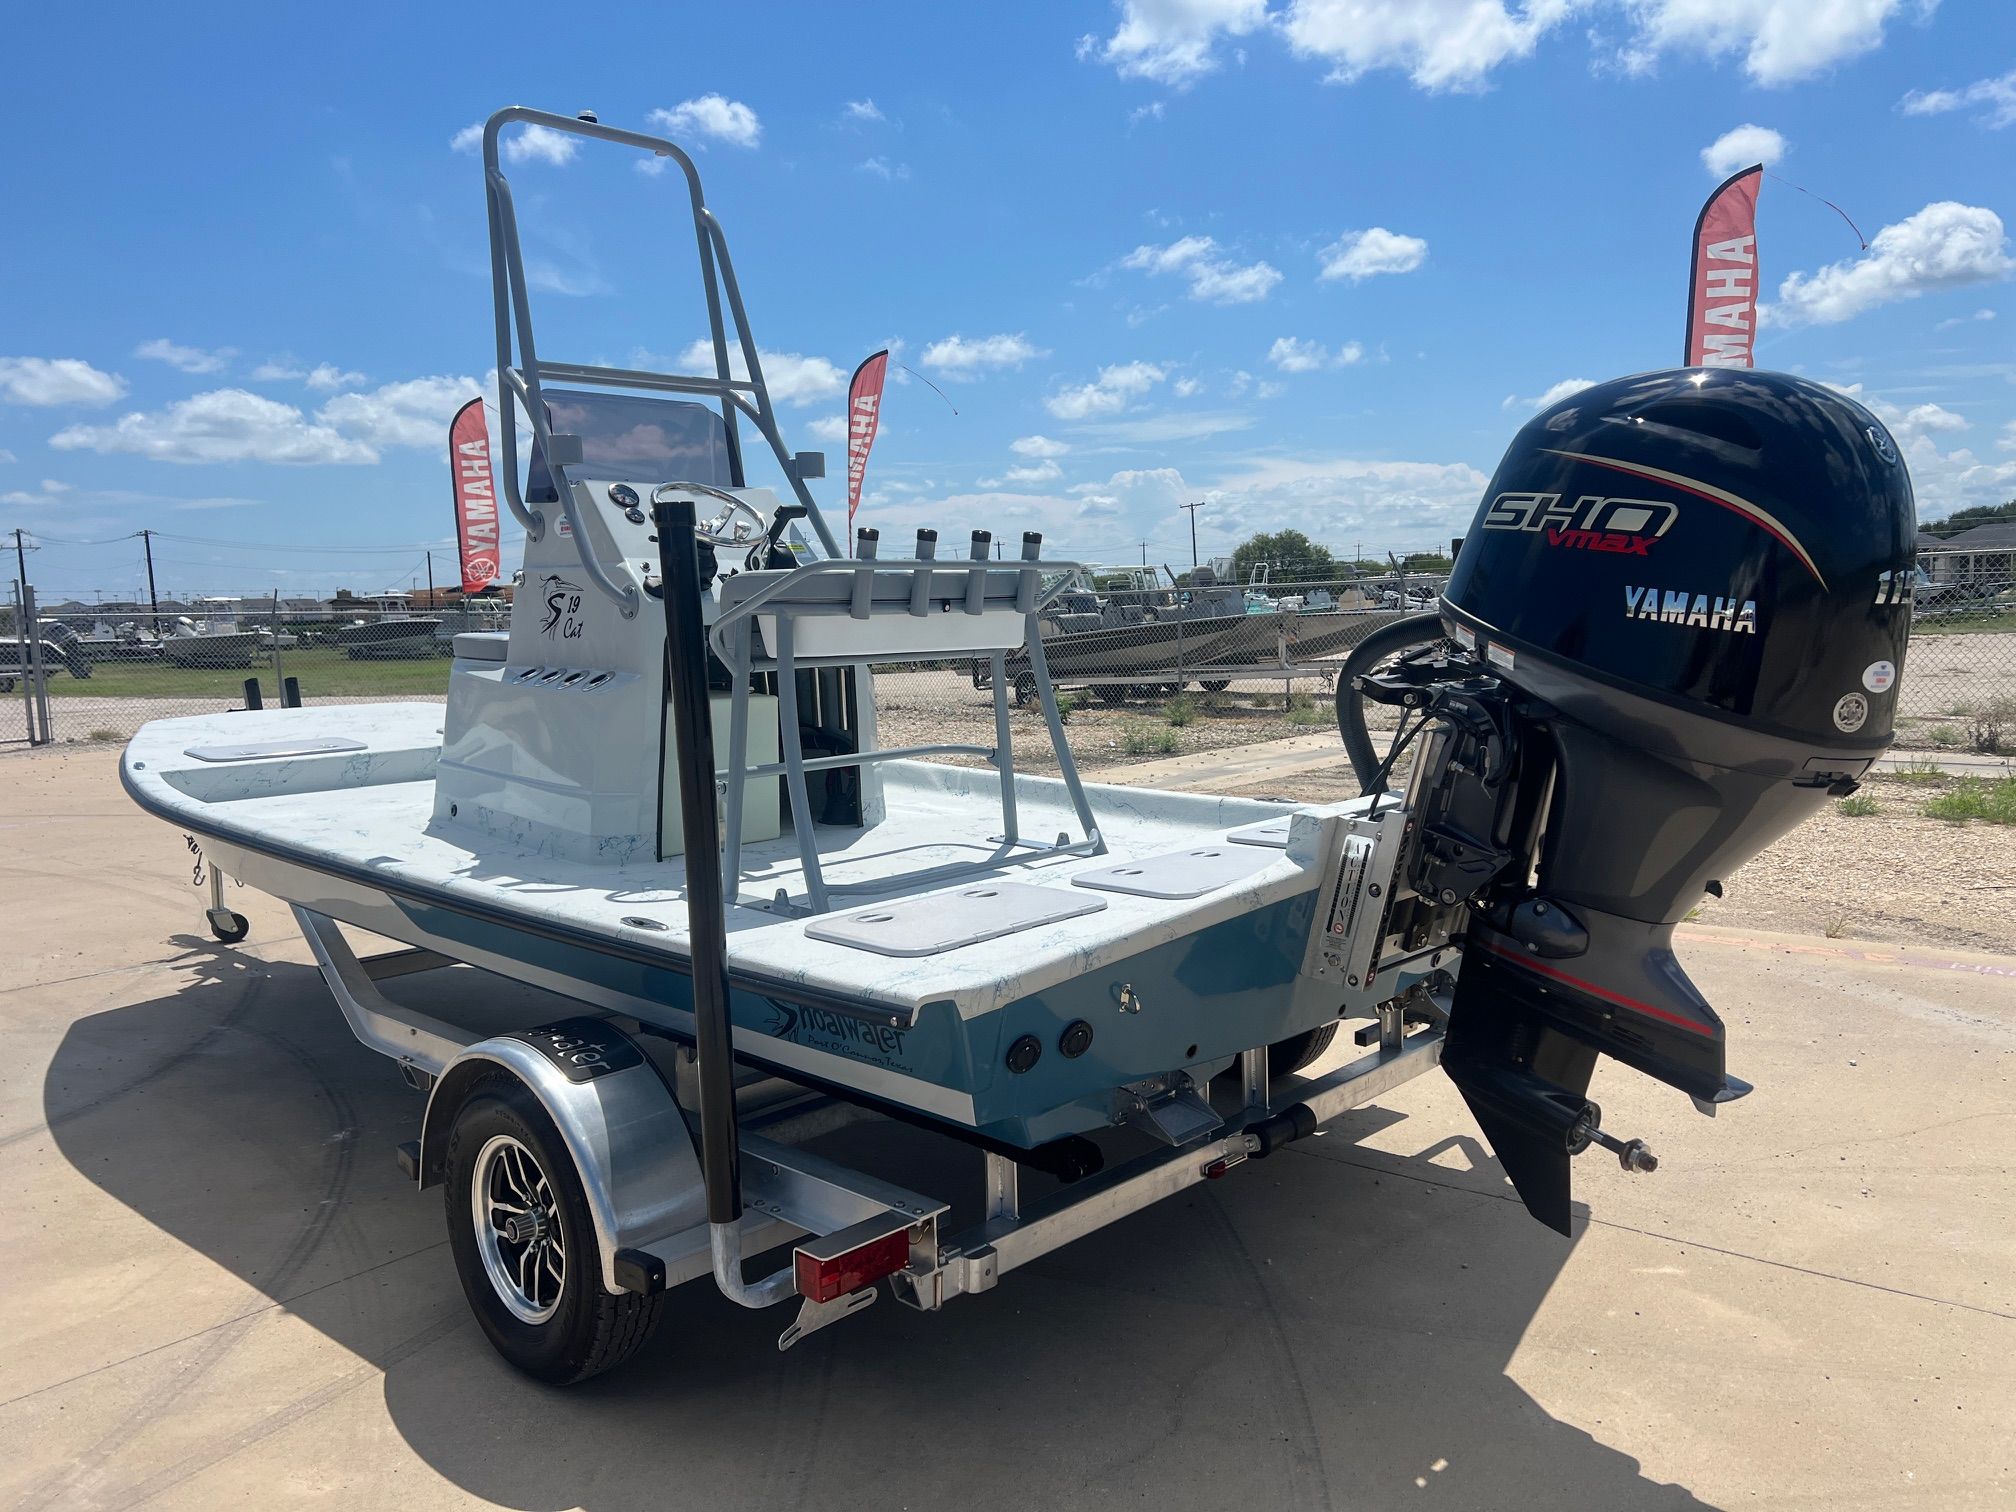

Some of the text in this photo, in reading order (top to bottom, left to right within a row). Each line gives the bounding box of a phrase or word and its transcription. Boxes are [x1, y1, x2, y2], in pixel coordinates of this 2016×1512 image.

[1702, 234, 1755, 368] MAHA
[458, 438, 497, 556] YAMAHA
[1482, 491, 1680, 537] SHO
[563, 617, 584, 639] Cat
[567, 595, 581, 614] 19
[1624, 585, 1757, 635] YAMAHA
